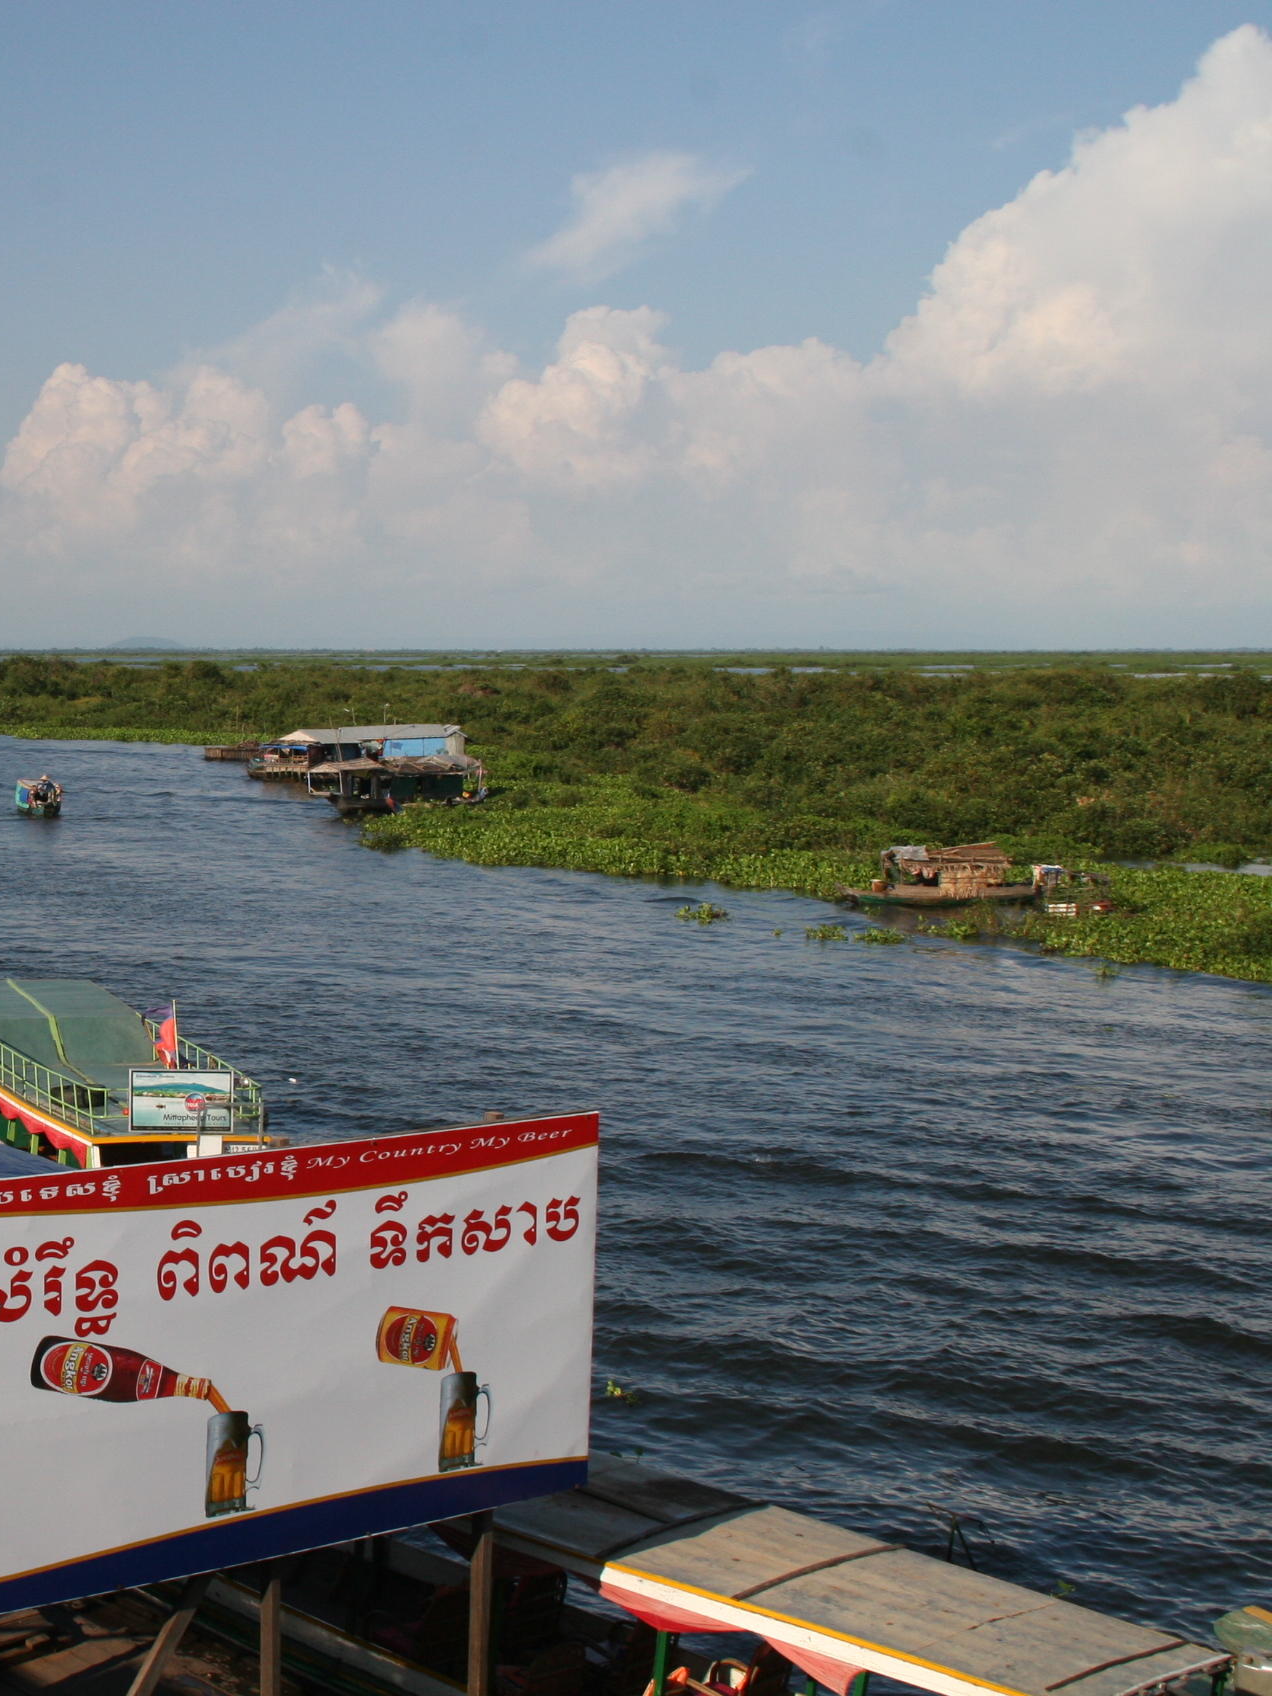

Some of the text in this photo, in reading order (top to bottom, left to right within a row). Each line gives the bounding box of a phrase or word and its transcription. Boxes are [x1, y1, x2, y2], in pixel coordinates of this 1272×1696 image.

[306, 1127, 573, 1169] My Country My Beer
[63, 1346, 85, 1390] Angkor
